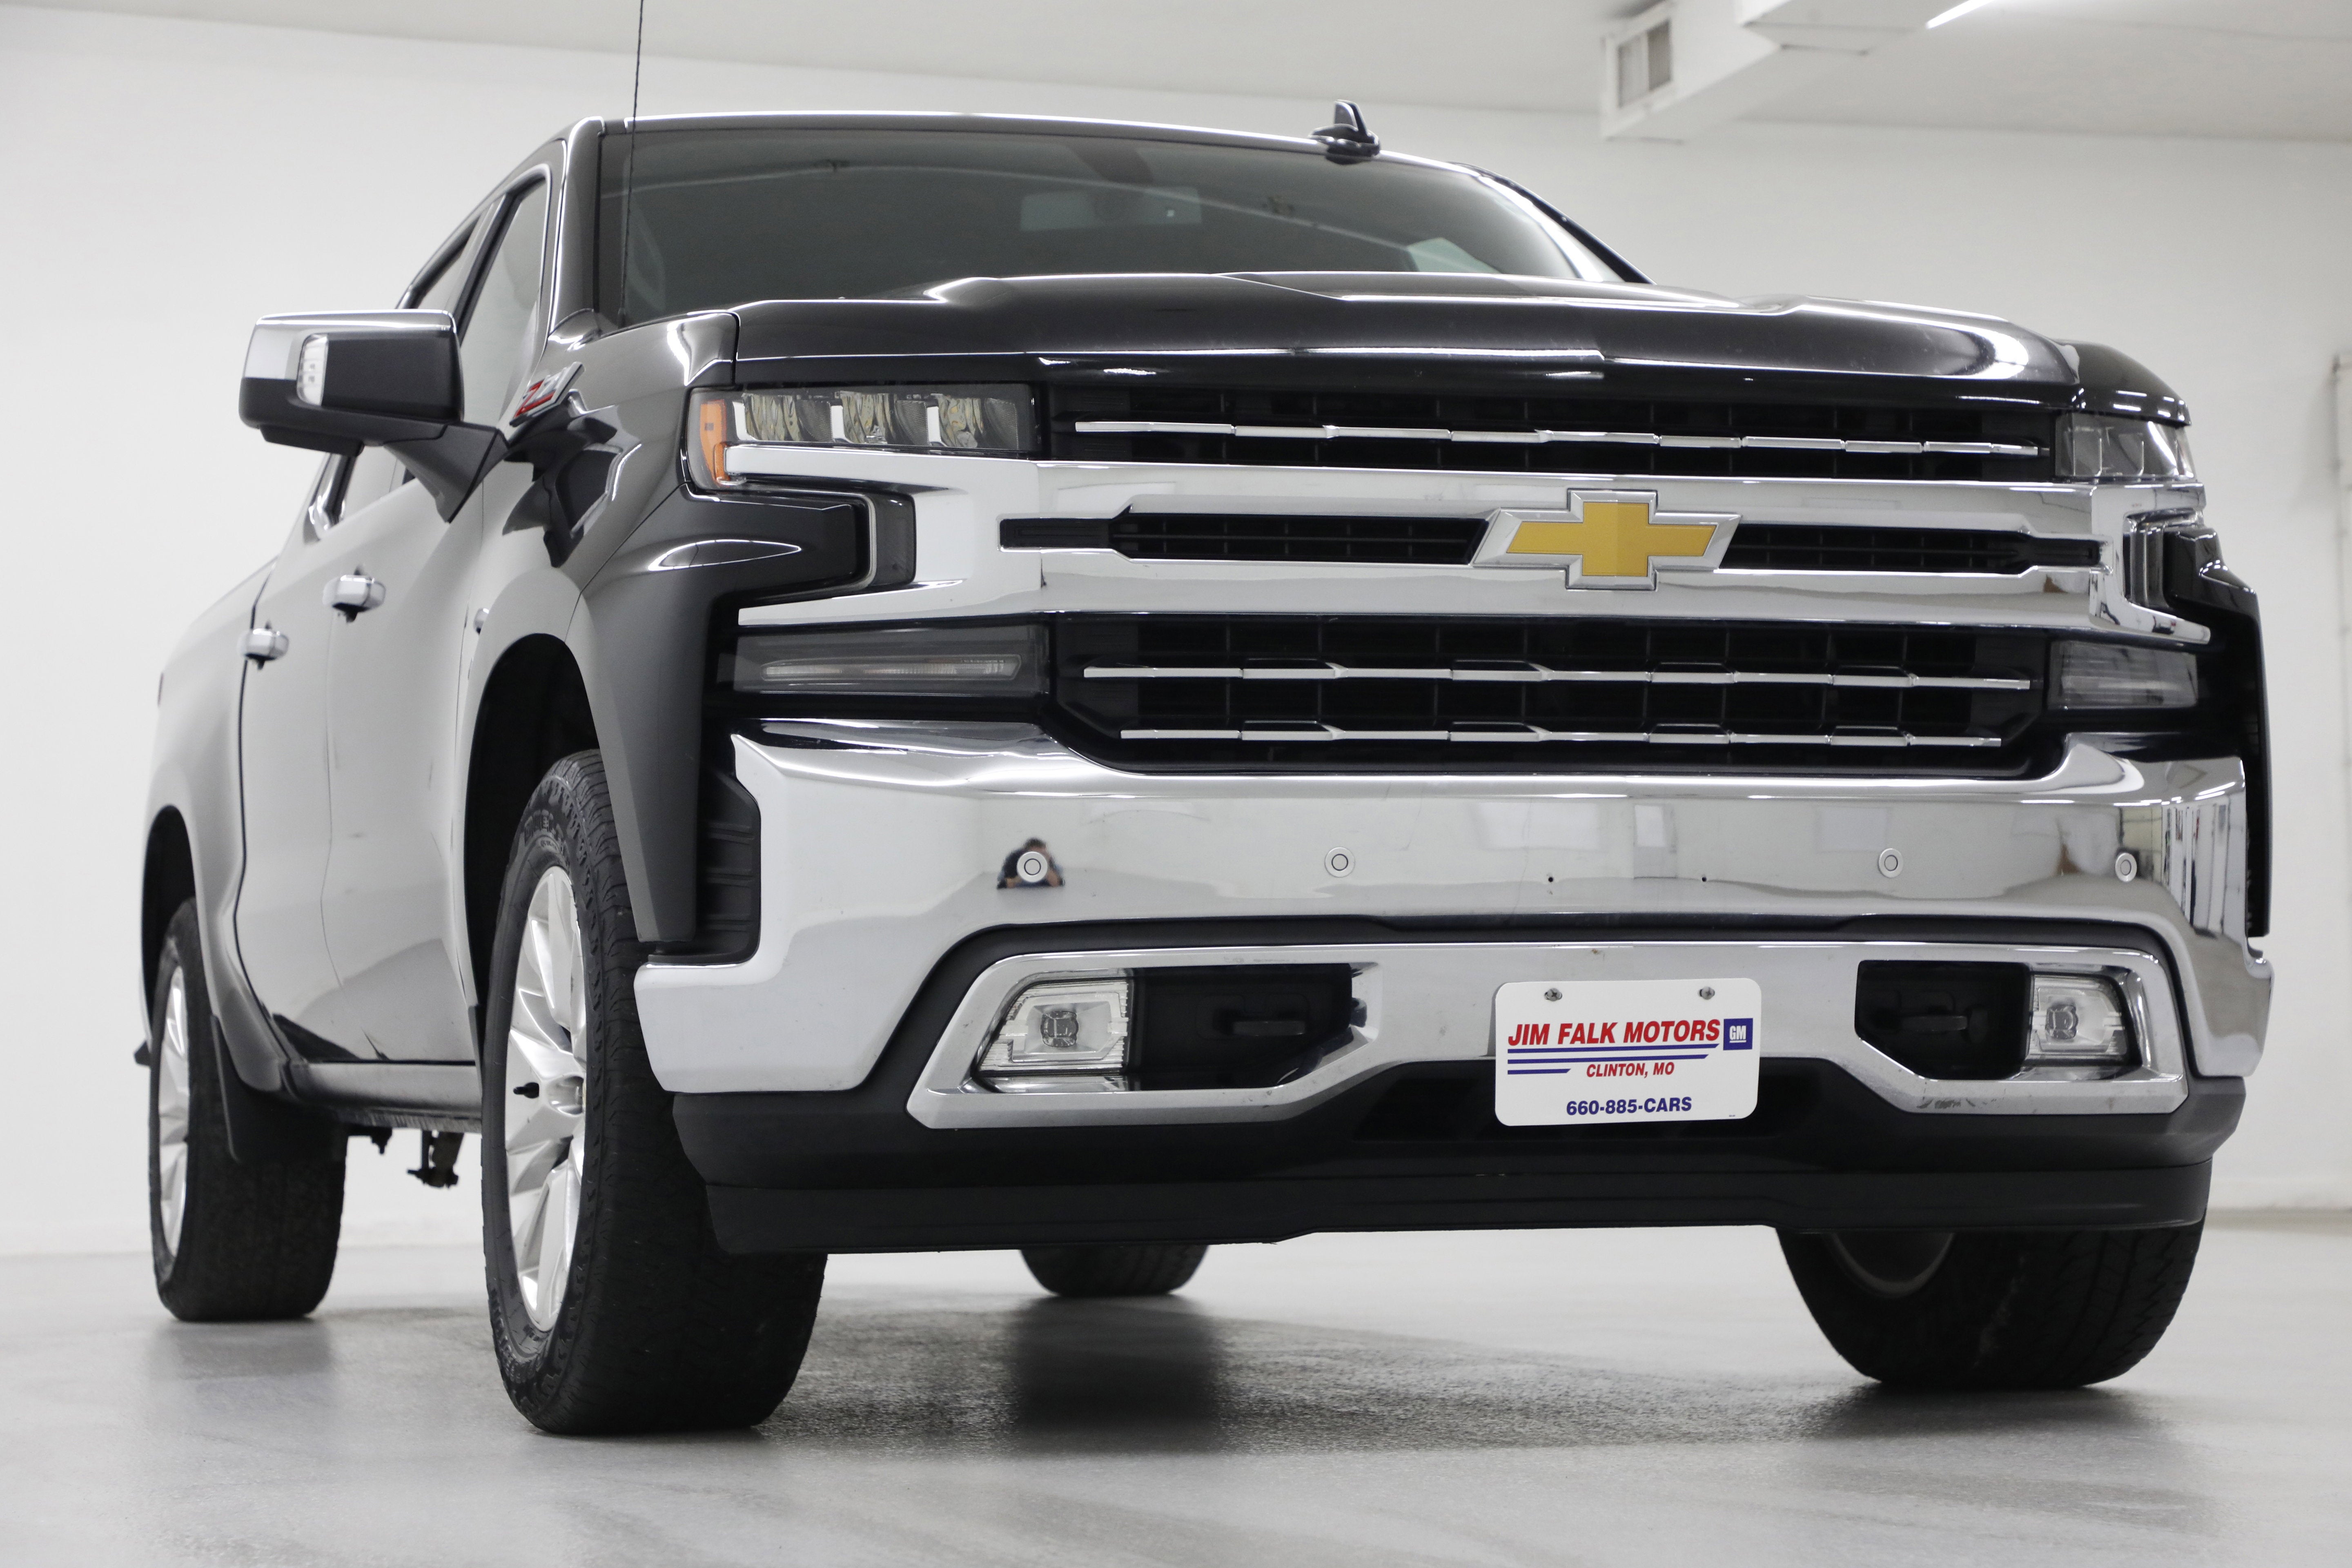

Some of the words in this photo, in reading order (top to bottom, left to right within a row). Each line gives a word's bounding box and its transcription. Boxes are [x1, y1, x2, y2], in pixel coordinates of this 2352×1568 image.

[1508, 1024, 1550, 1046] JIM
[1557, 1022, 1617, 1045] FALK
[1623, 1019, 1720, 1043] MOTORS
[1729, 1025, 1746, 1040] GM
[1586, 1063, 1648, 1078] CLINTON,
[1653, 1062, 1675, 1075] MO
[1567, 1097, 1692, 1115] 660-885-CARS
